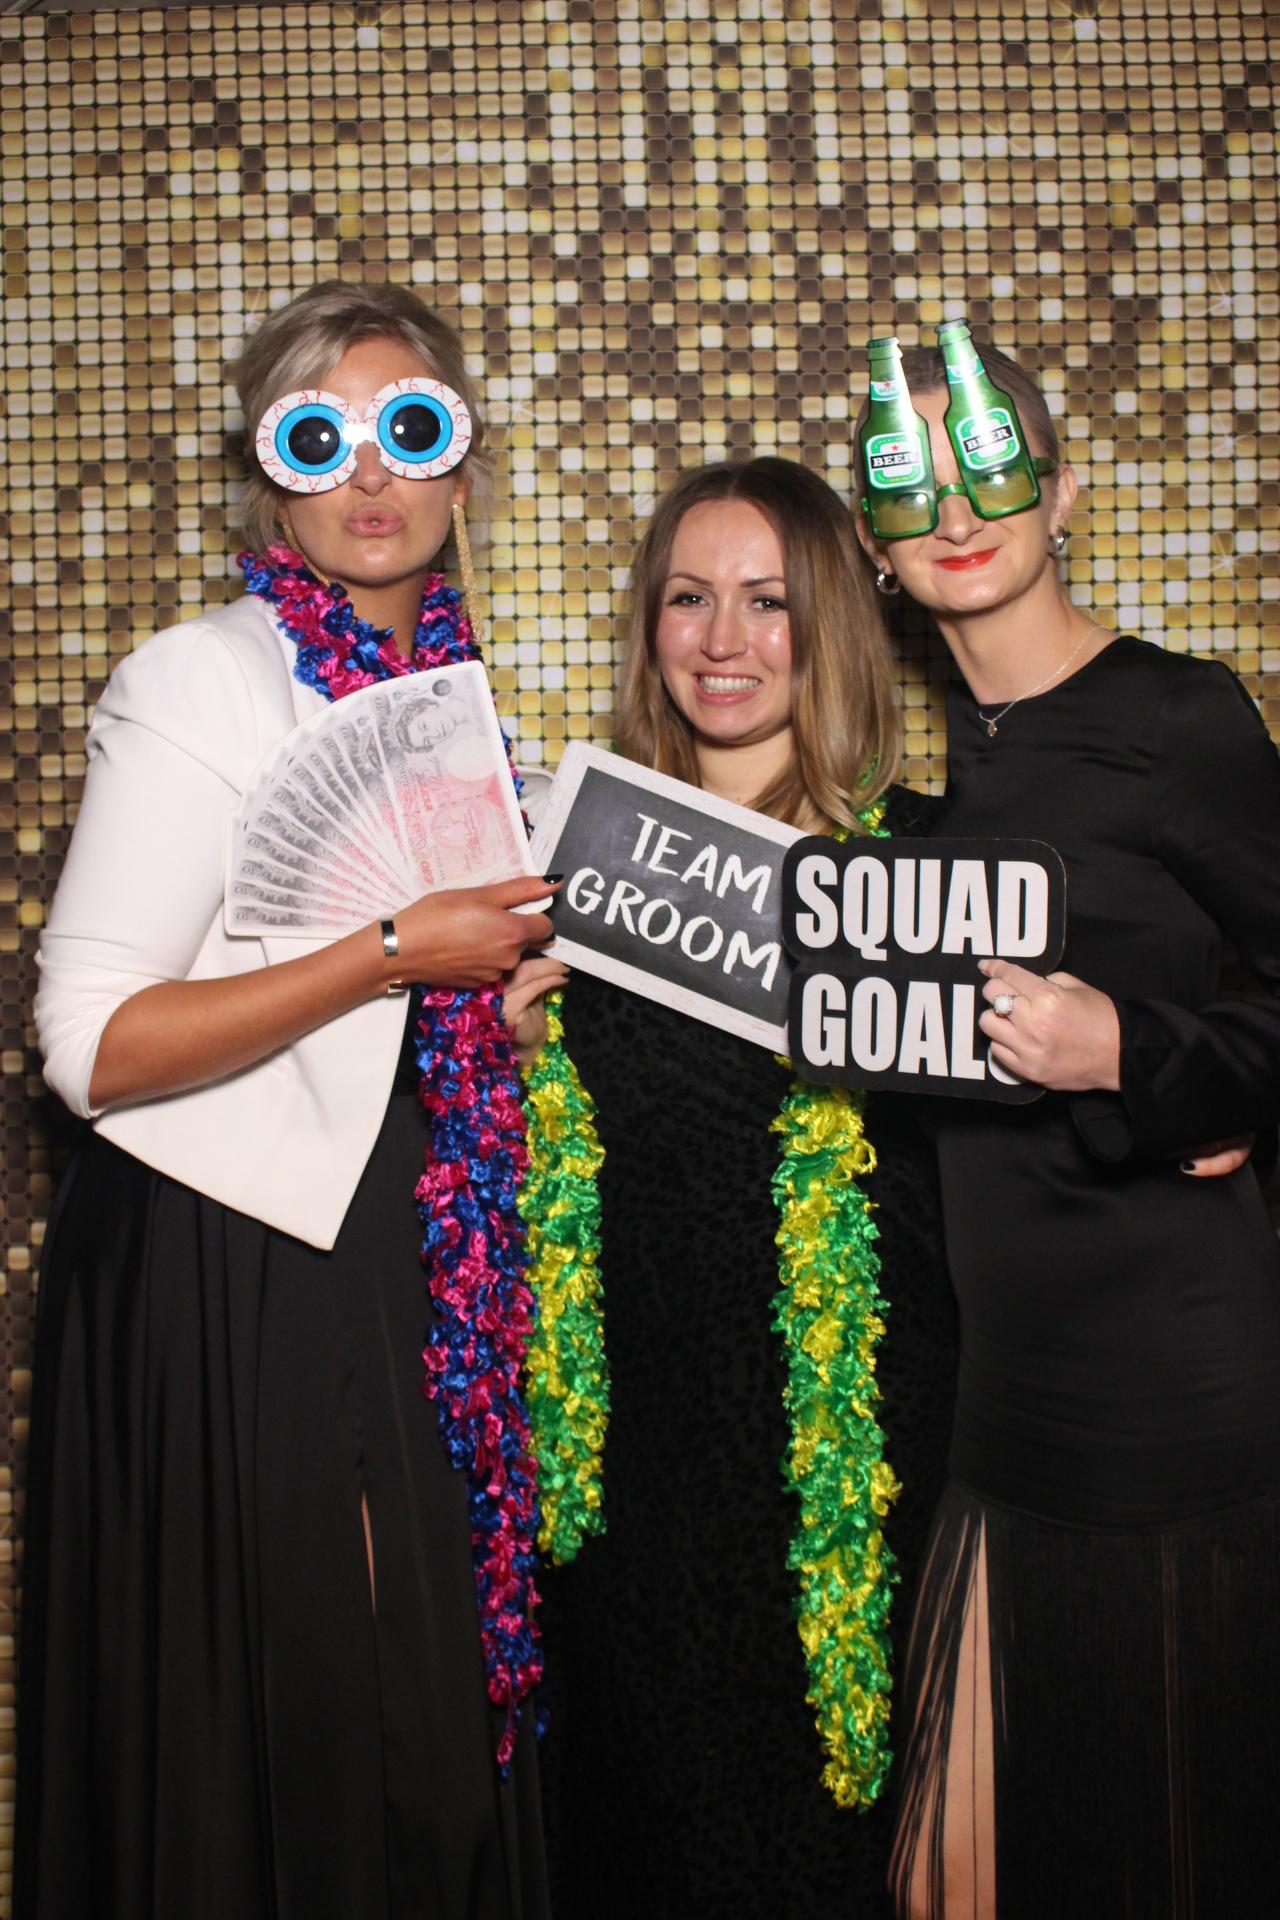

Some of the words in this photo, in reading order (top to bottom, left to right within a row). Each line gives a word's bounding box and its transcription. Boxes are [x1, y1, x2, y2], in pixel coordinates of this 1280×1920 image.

[873, 451, 919, 468] BEER
[966, 428, 1010, 451] BEER
[630, 813, 772, 914] TEAM
[795, 854, 1049, 961] SQUAD
[567, 867, 782, 992] GROOM
